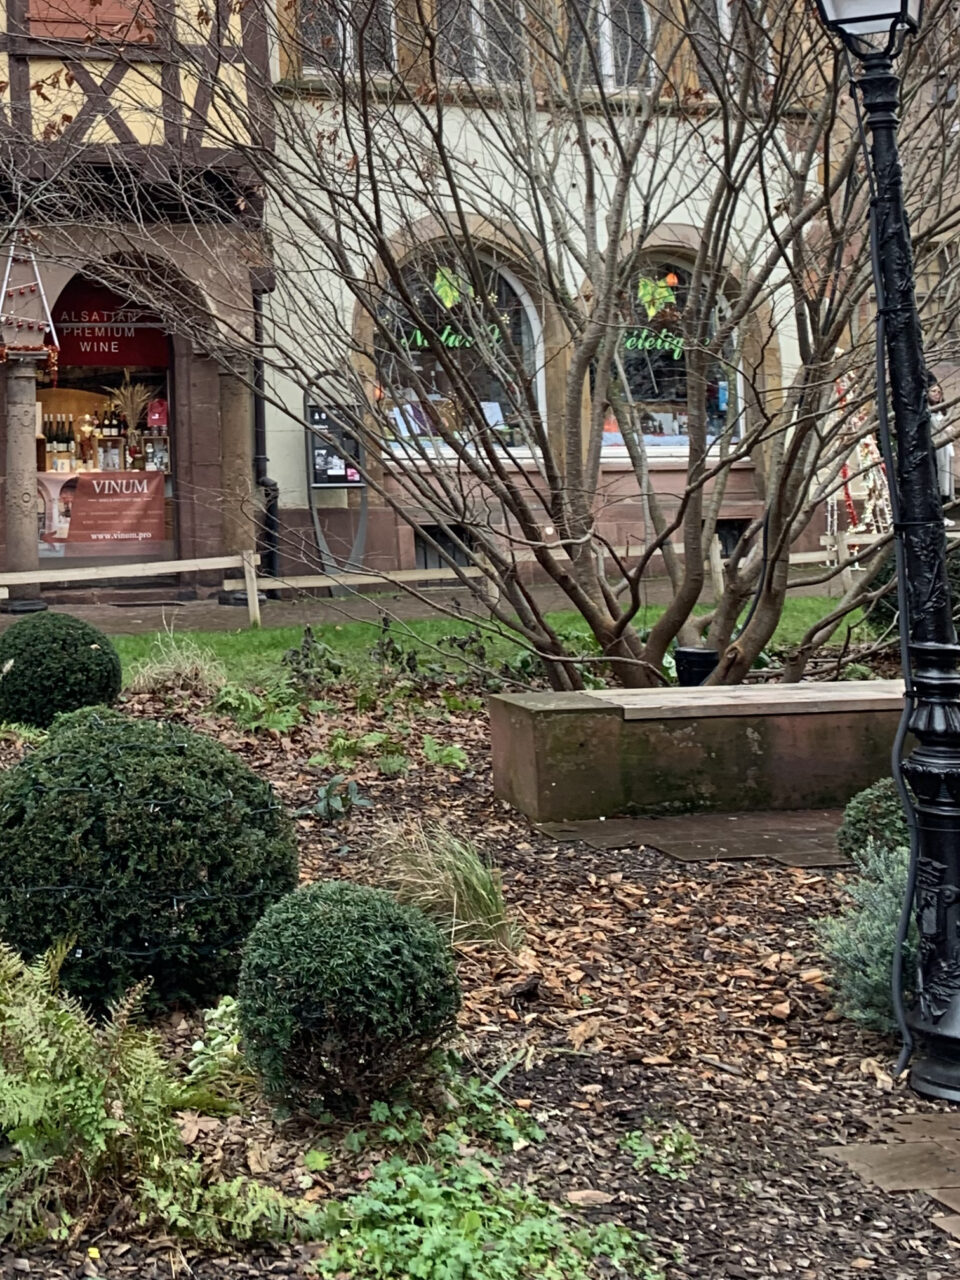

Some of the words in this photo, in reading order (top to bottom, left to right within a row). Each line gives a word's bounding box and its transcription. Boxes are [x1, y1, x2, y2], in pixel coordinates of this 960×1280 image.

[60, 310, 137, 322] ALSATIAN
[63, 325, 135, 337] PREMIUM
[80, 341, 119, 352] WINE
[92, 479, 148, 494] VINUM
[90, 531, 152, 540] www.vinum.pro
